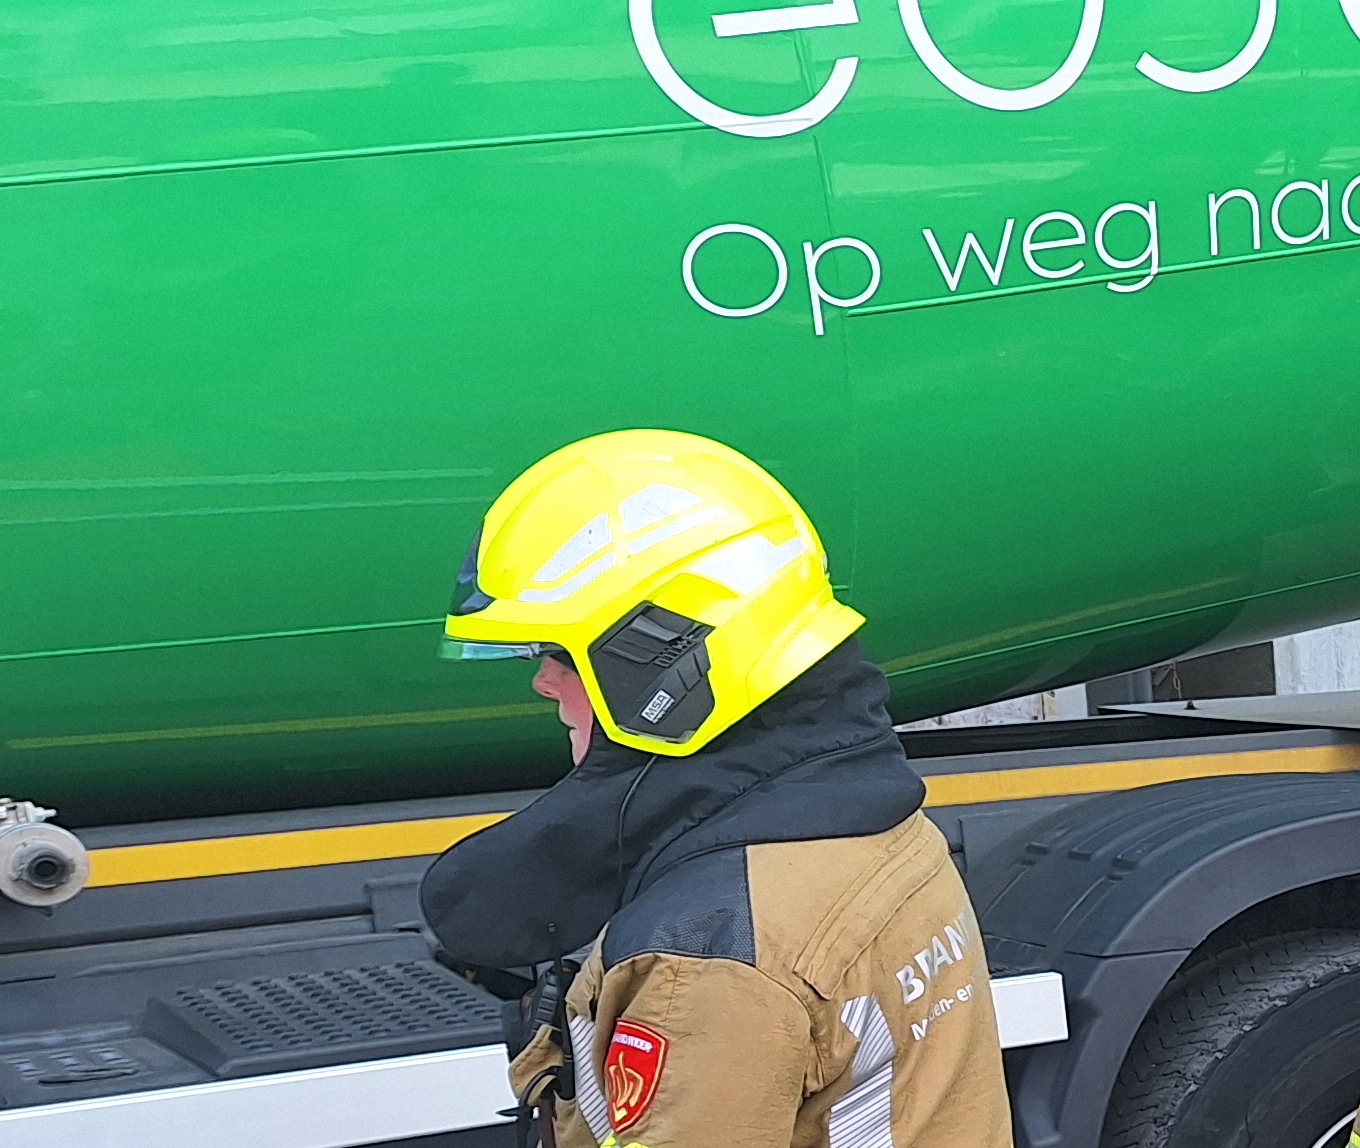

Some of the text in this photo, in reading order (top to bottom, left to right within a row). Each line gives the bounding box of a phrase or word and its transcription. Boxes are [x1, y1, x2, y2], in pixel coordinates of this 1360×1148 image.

[683, 223, 881, 336] Op
[921, 200, 1159, 293] weg
[645, 695, 668, 718] MSA
